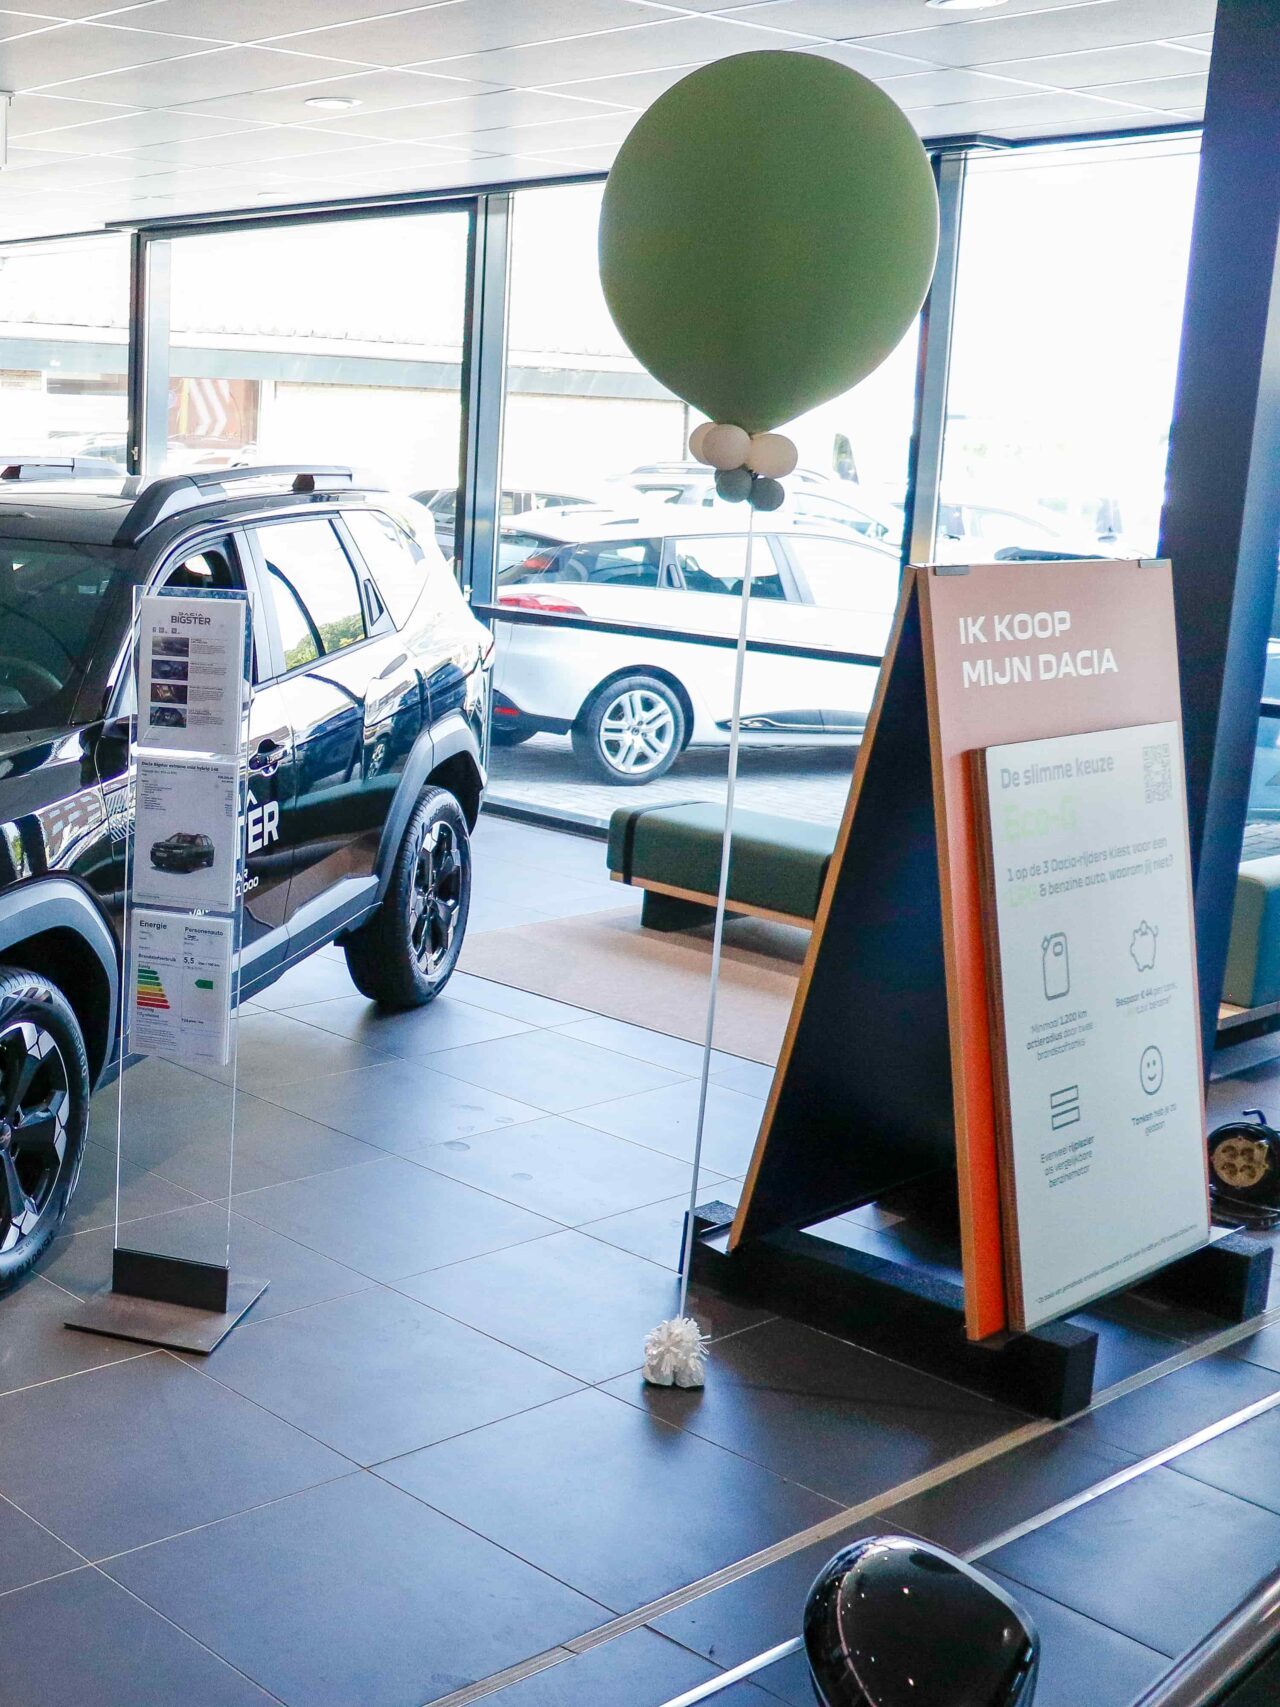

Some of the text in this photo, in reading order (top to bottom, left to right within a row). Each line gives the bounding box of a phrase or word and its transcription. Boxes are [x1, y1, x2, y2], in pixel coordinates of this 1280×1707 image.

[171, 615, 211, 626] BIGSTER
[959, 611, 1071, 645] IK KOOP
[962, 648, 1119, 689] MIJN DACIA
[1000, 755, 1115, 789] De slimme keuze
[1007, 837, 1168, 884] 1 op de 3 Dacia-rijders kiest voor een
[1039, 883, 1047, 897] &
[1048, 876, 1084, 895] benzine
[1109, 862, 1144, 881] waarom
[139, 920, 168, 931] Energie
[184, 926, 224, 937] Personenauto
[183, 956, 195, 965] 5,5
[1026, 1032, 1063, 1051] actieradius
[1040, 1147, 1067, 1164] Evenveel
